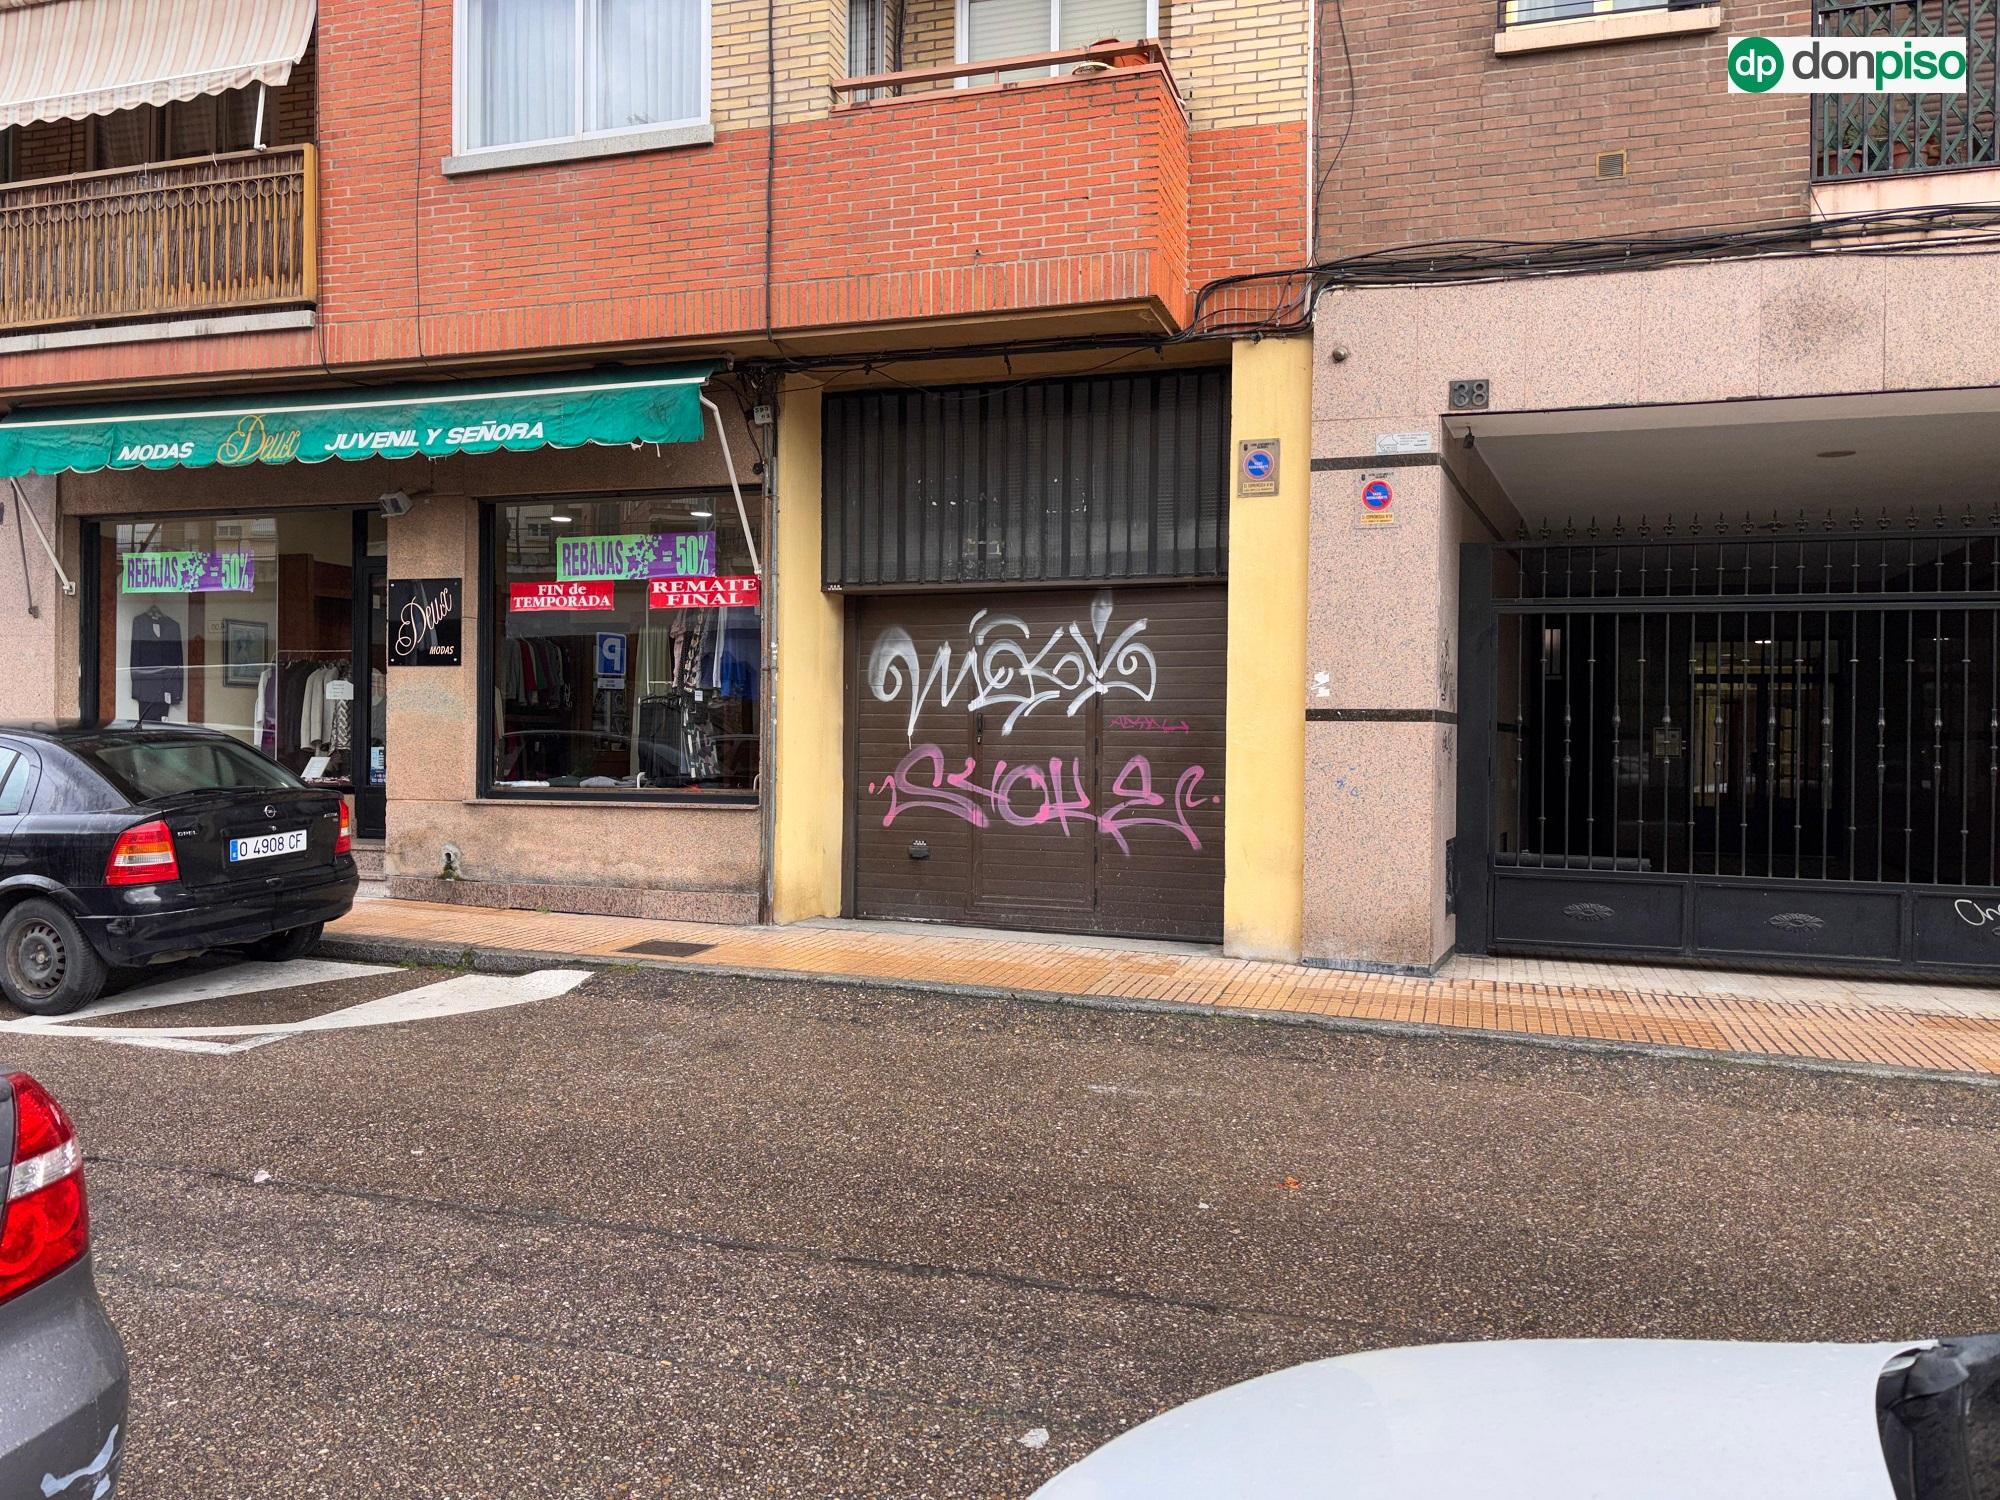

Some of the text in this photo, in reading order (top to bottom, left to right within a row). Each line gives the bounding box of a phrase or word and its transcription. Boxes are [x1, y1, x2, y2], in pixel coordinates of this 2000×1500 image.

[1454, 381, 1488, 407] 38
[117, 442, 195, 461] MODAS
[325, 429, 420, 451] JUVENIL
[426, 428, 443, 446] Y
[445, 420, 543, 445] SEÑORA
[562, 540, 624, 577] REBAJAS
[127, 556, 179, 588] REBAJAS
[538, 582, 587, 596] FIN de
[652, 578, 757, 594] REMATE
[513, 594, 611, 609] TEMPORADA
[666, 592, 744, 606] FINAL
[395, 587, 453, 657] Deux
[429, 645, 455, 655] MODAS
[253, 836, 285, 855] 4908
[288, 832, 303, 850] CF
